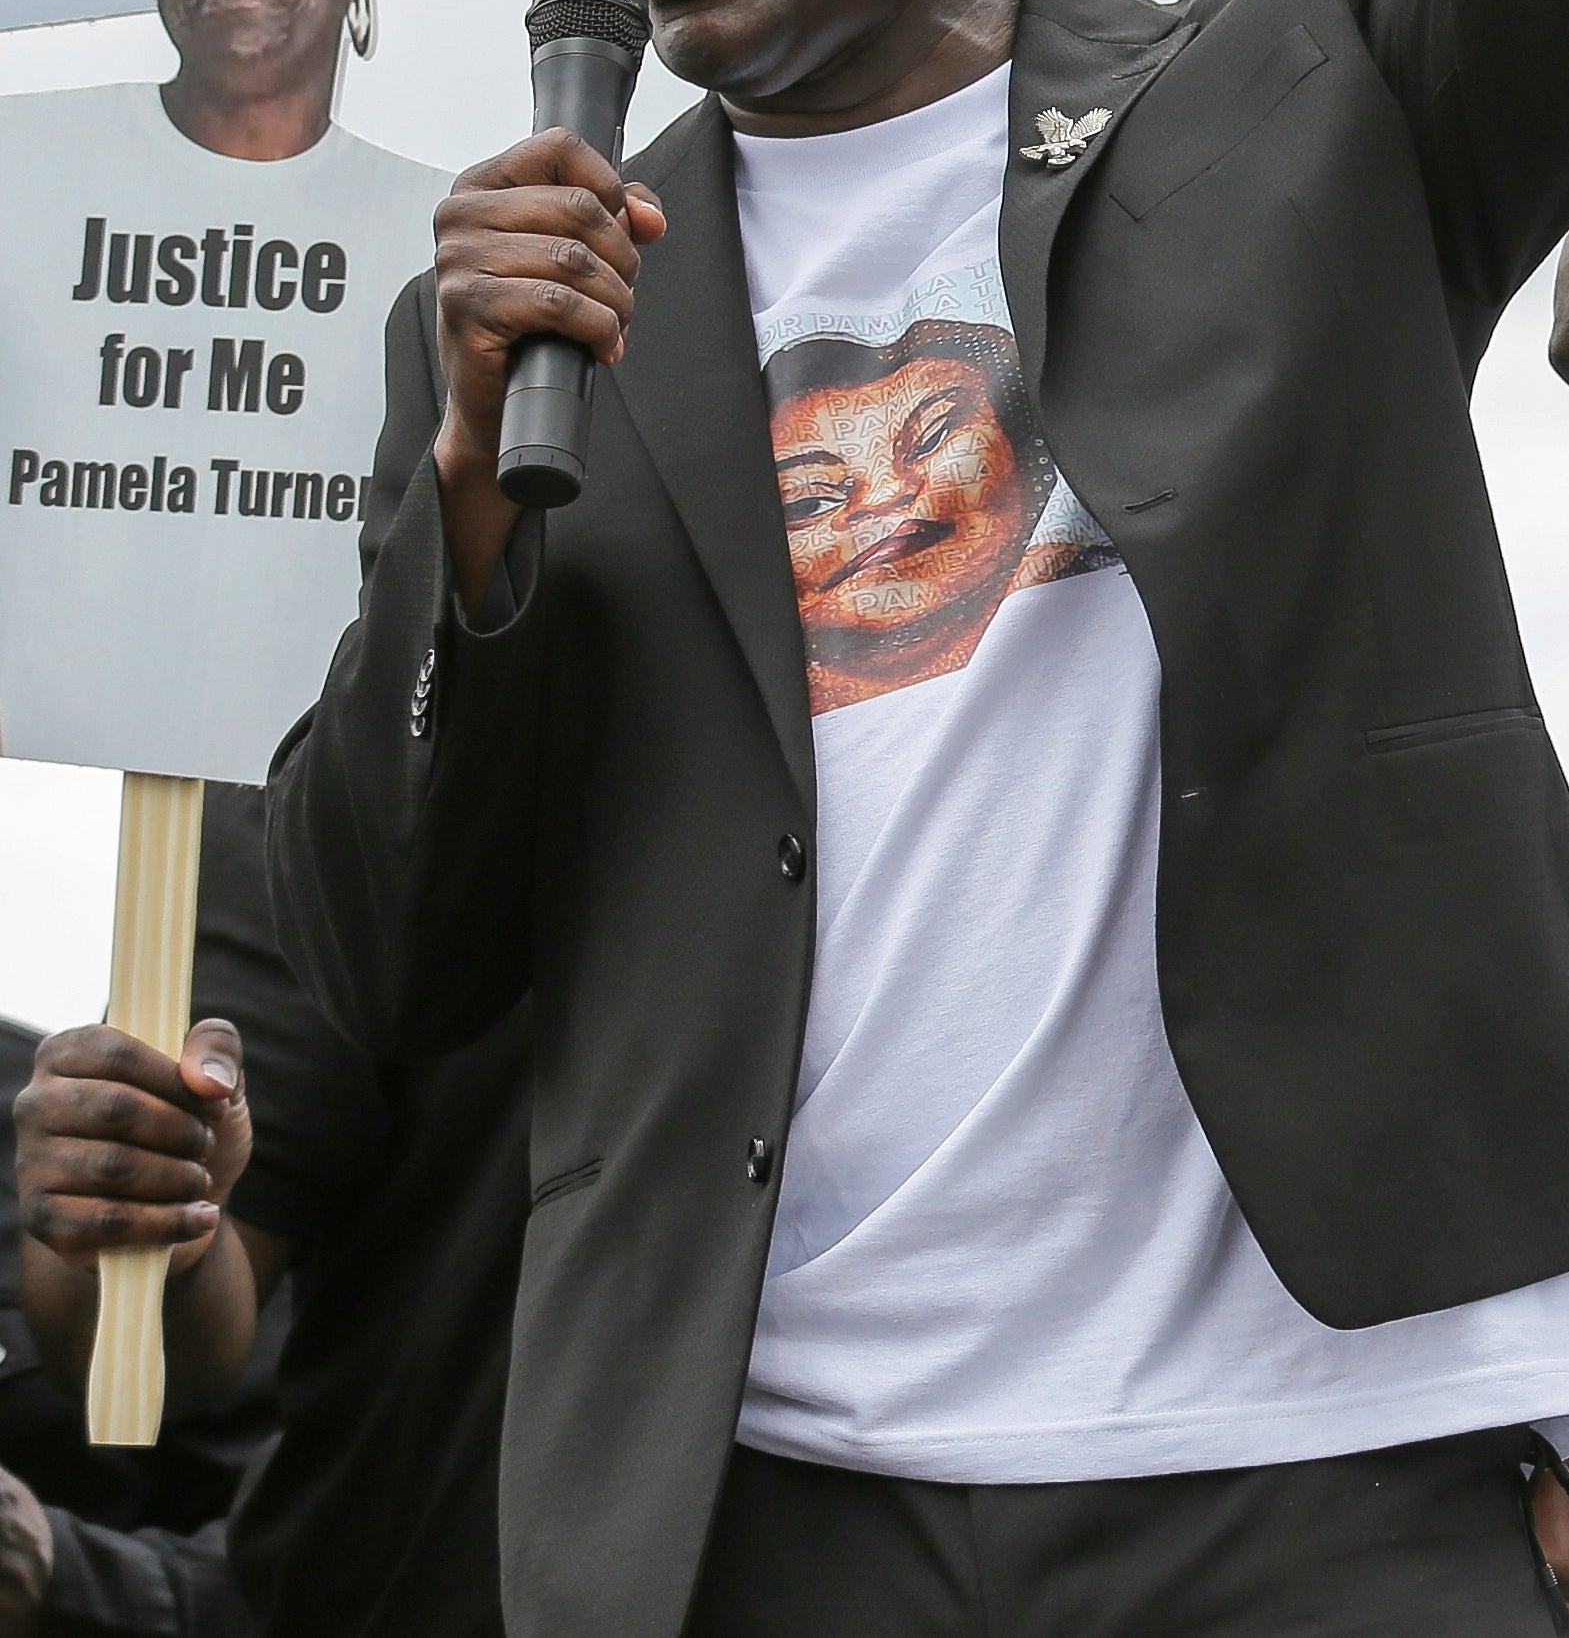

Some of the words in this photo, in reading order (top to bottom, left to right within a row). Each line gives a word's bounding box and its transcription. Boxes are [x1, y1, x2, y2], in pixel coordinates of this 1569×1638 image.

[72, 216, 347, 313] Justice
[99, 333, 195, 409] for
[207, 337, 305, 415] Me
[9, 449, 197, 513] Pamela
